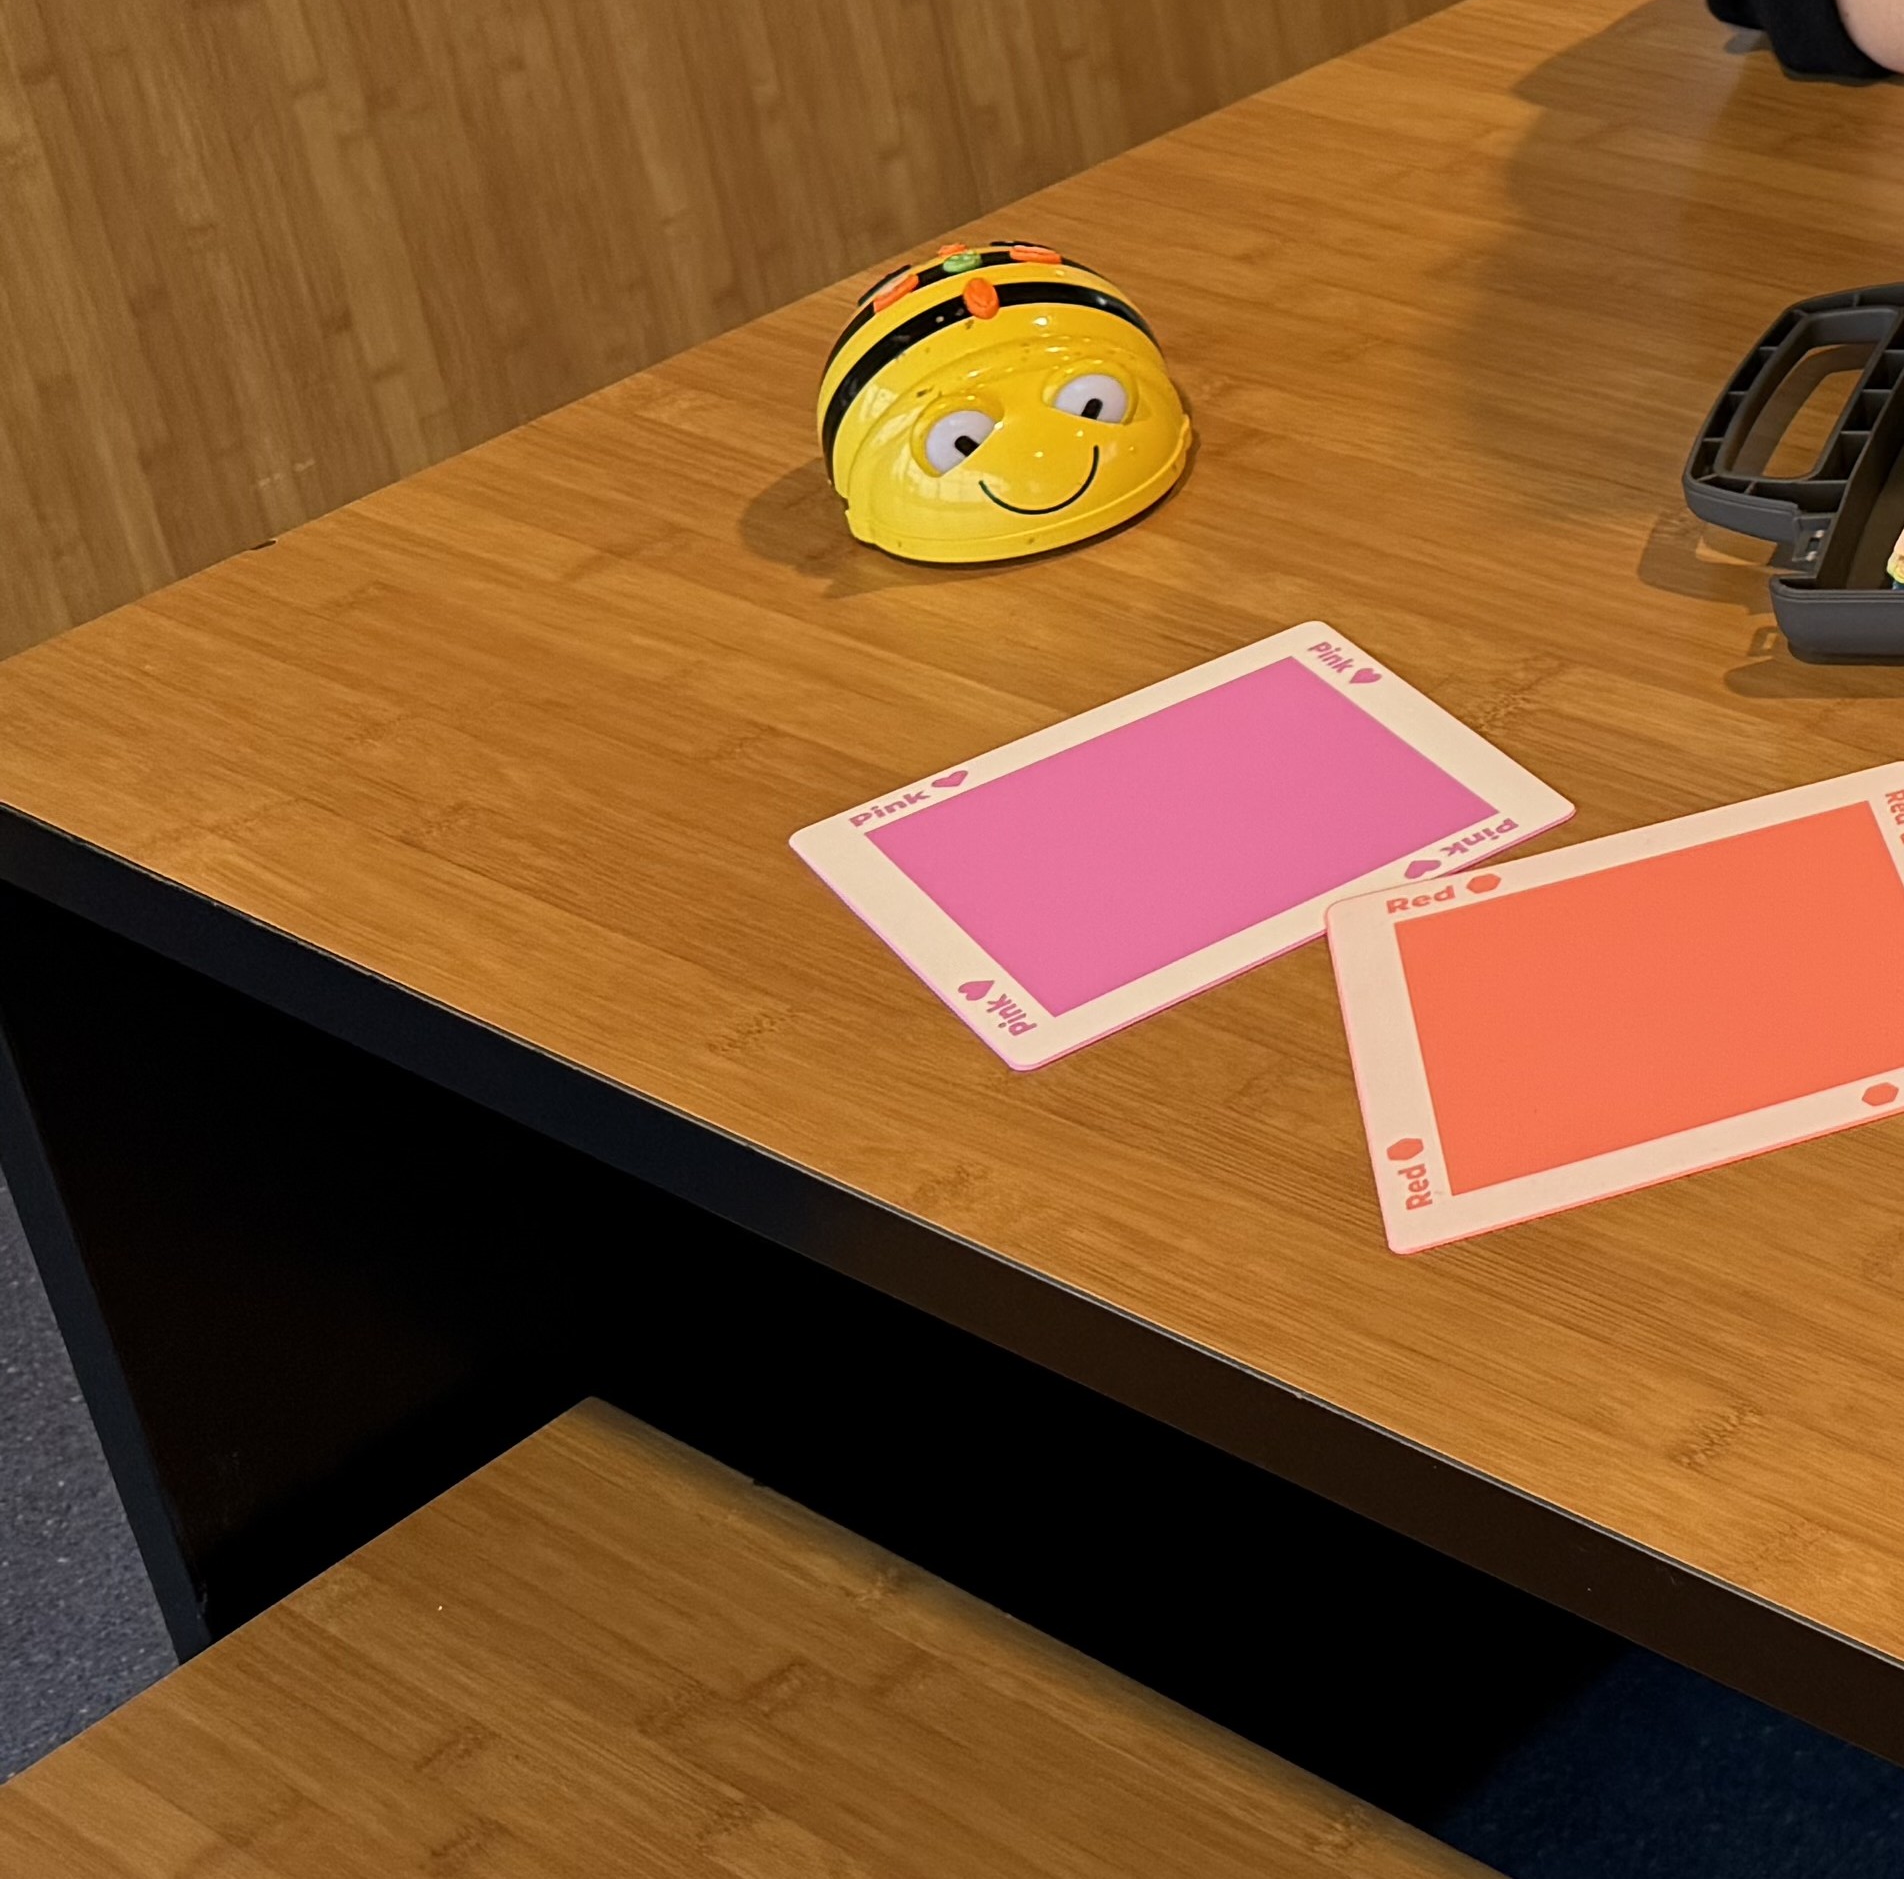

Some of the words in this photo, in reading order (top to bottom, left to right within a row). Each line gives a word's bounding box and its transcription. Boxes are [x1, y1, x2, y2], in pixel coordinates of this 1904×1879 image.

[1308, 641, 1353, 674] Pink
[848, 788, 931, 829] Pink
[1441, 818, 1518, 859] Pink
[1386, 884, 1456, 915] Red
[986, 993, 1037, 1037] Pink
[1398, 1163, 1433, 1211] Red
